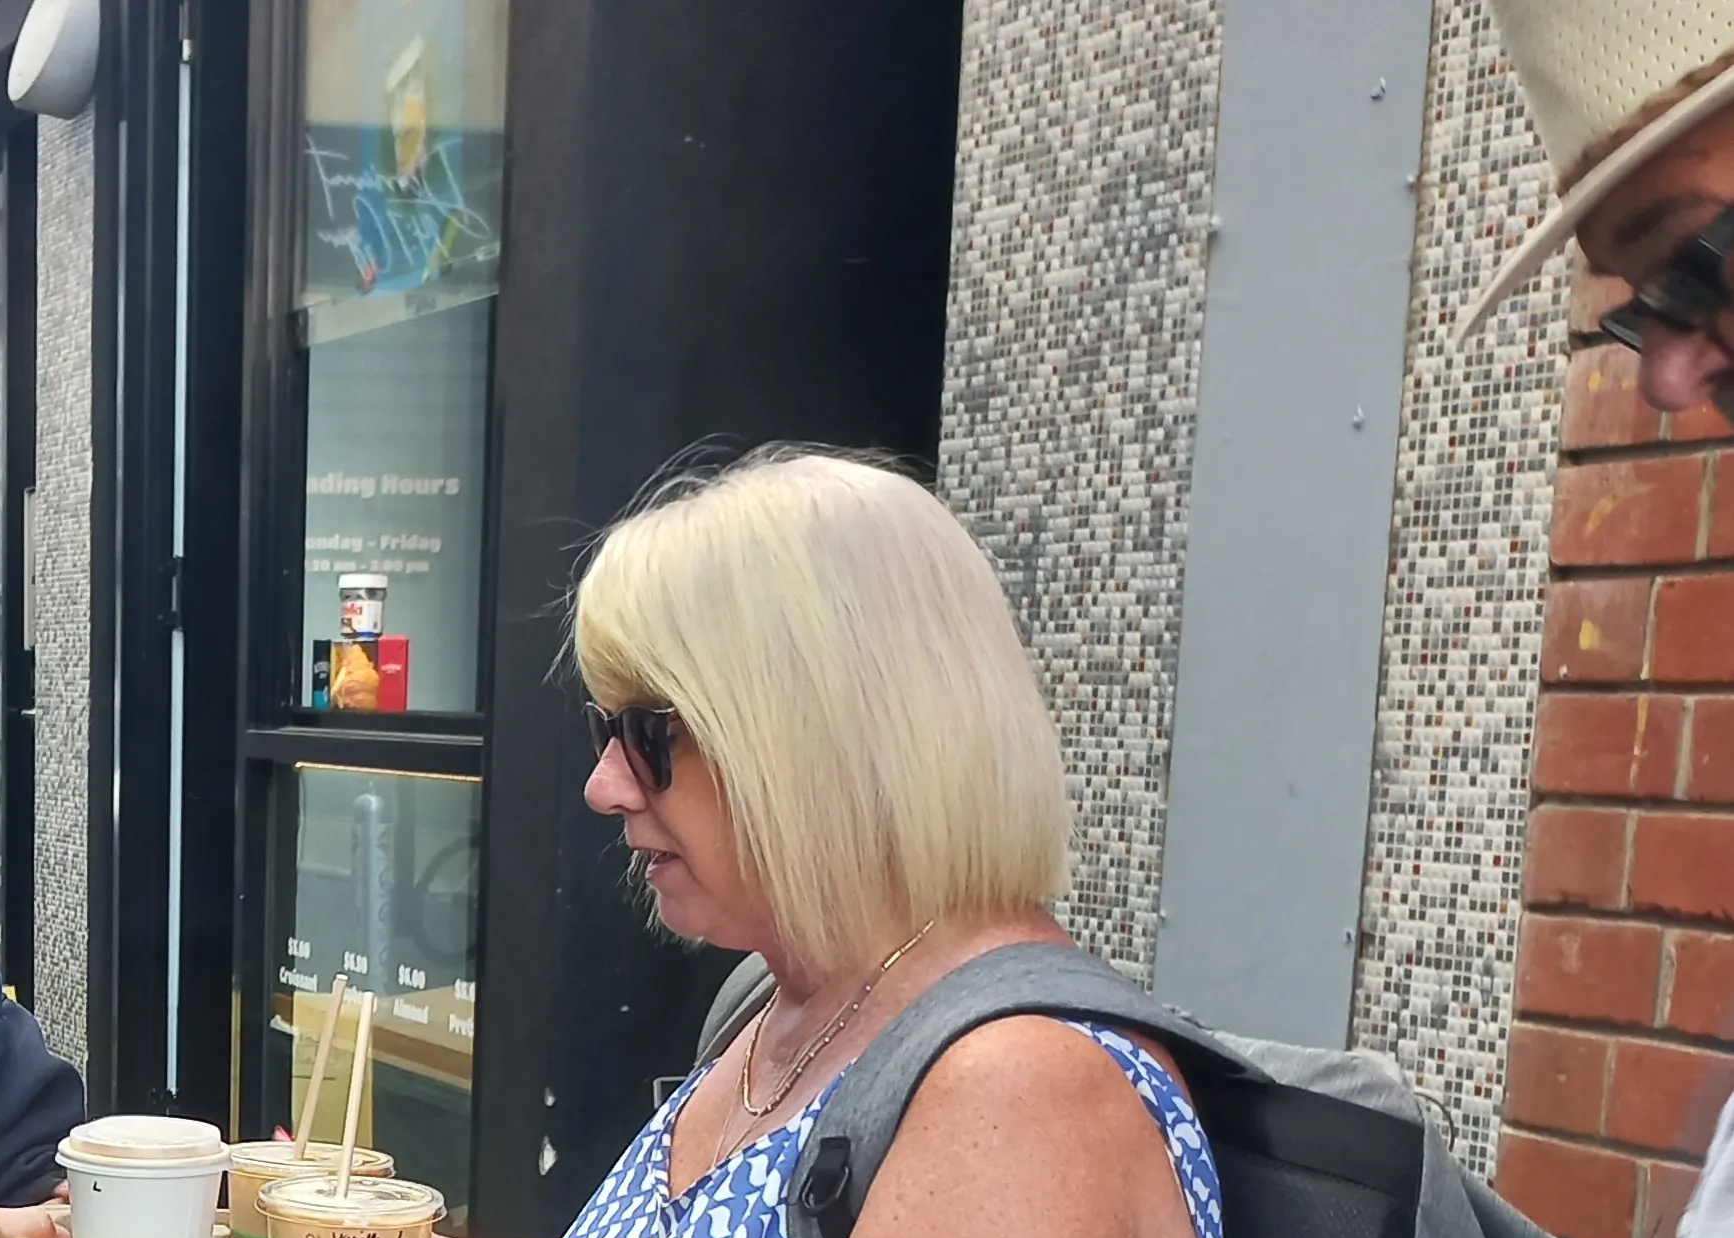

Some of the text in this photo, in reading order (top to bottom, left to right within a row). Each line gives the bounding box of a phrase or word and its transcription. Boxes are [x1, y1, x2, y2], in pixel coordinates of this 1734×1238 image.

[380, 473, 461, 496] Hours
[305, 533, 363, 553] onday
[379, 533, 442, 553] Friday
[92, 1180, 102, 1193] L
